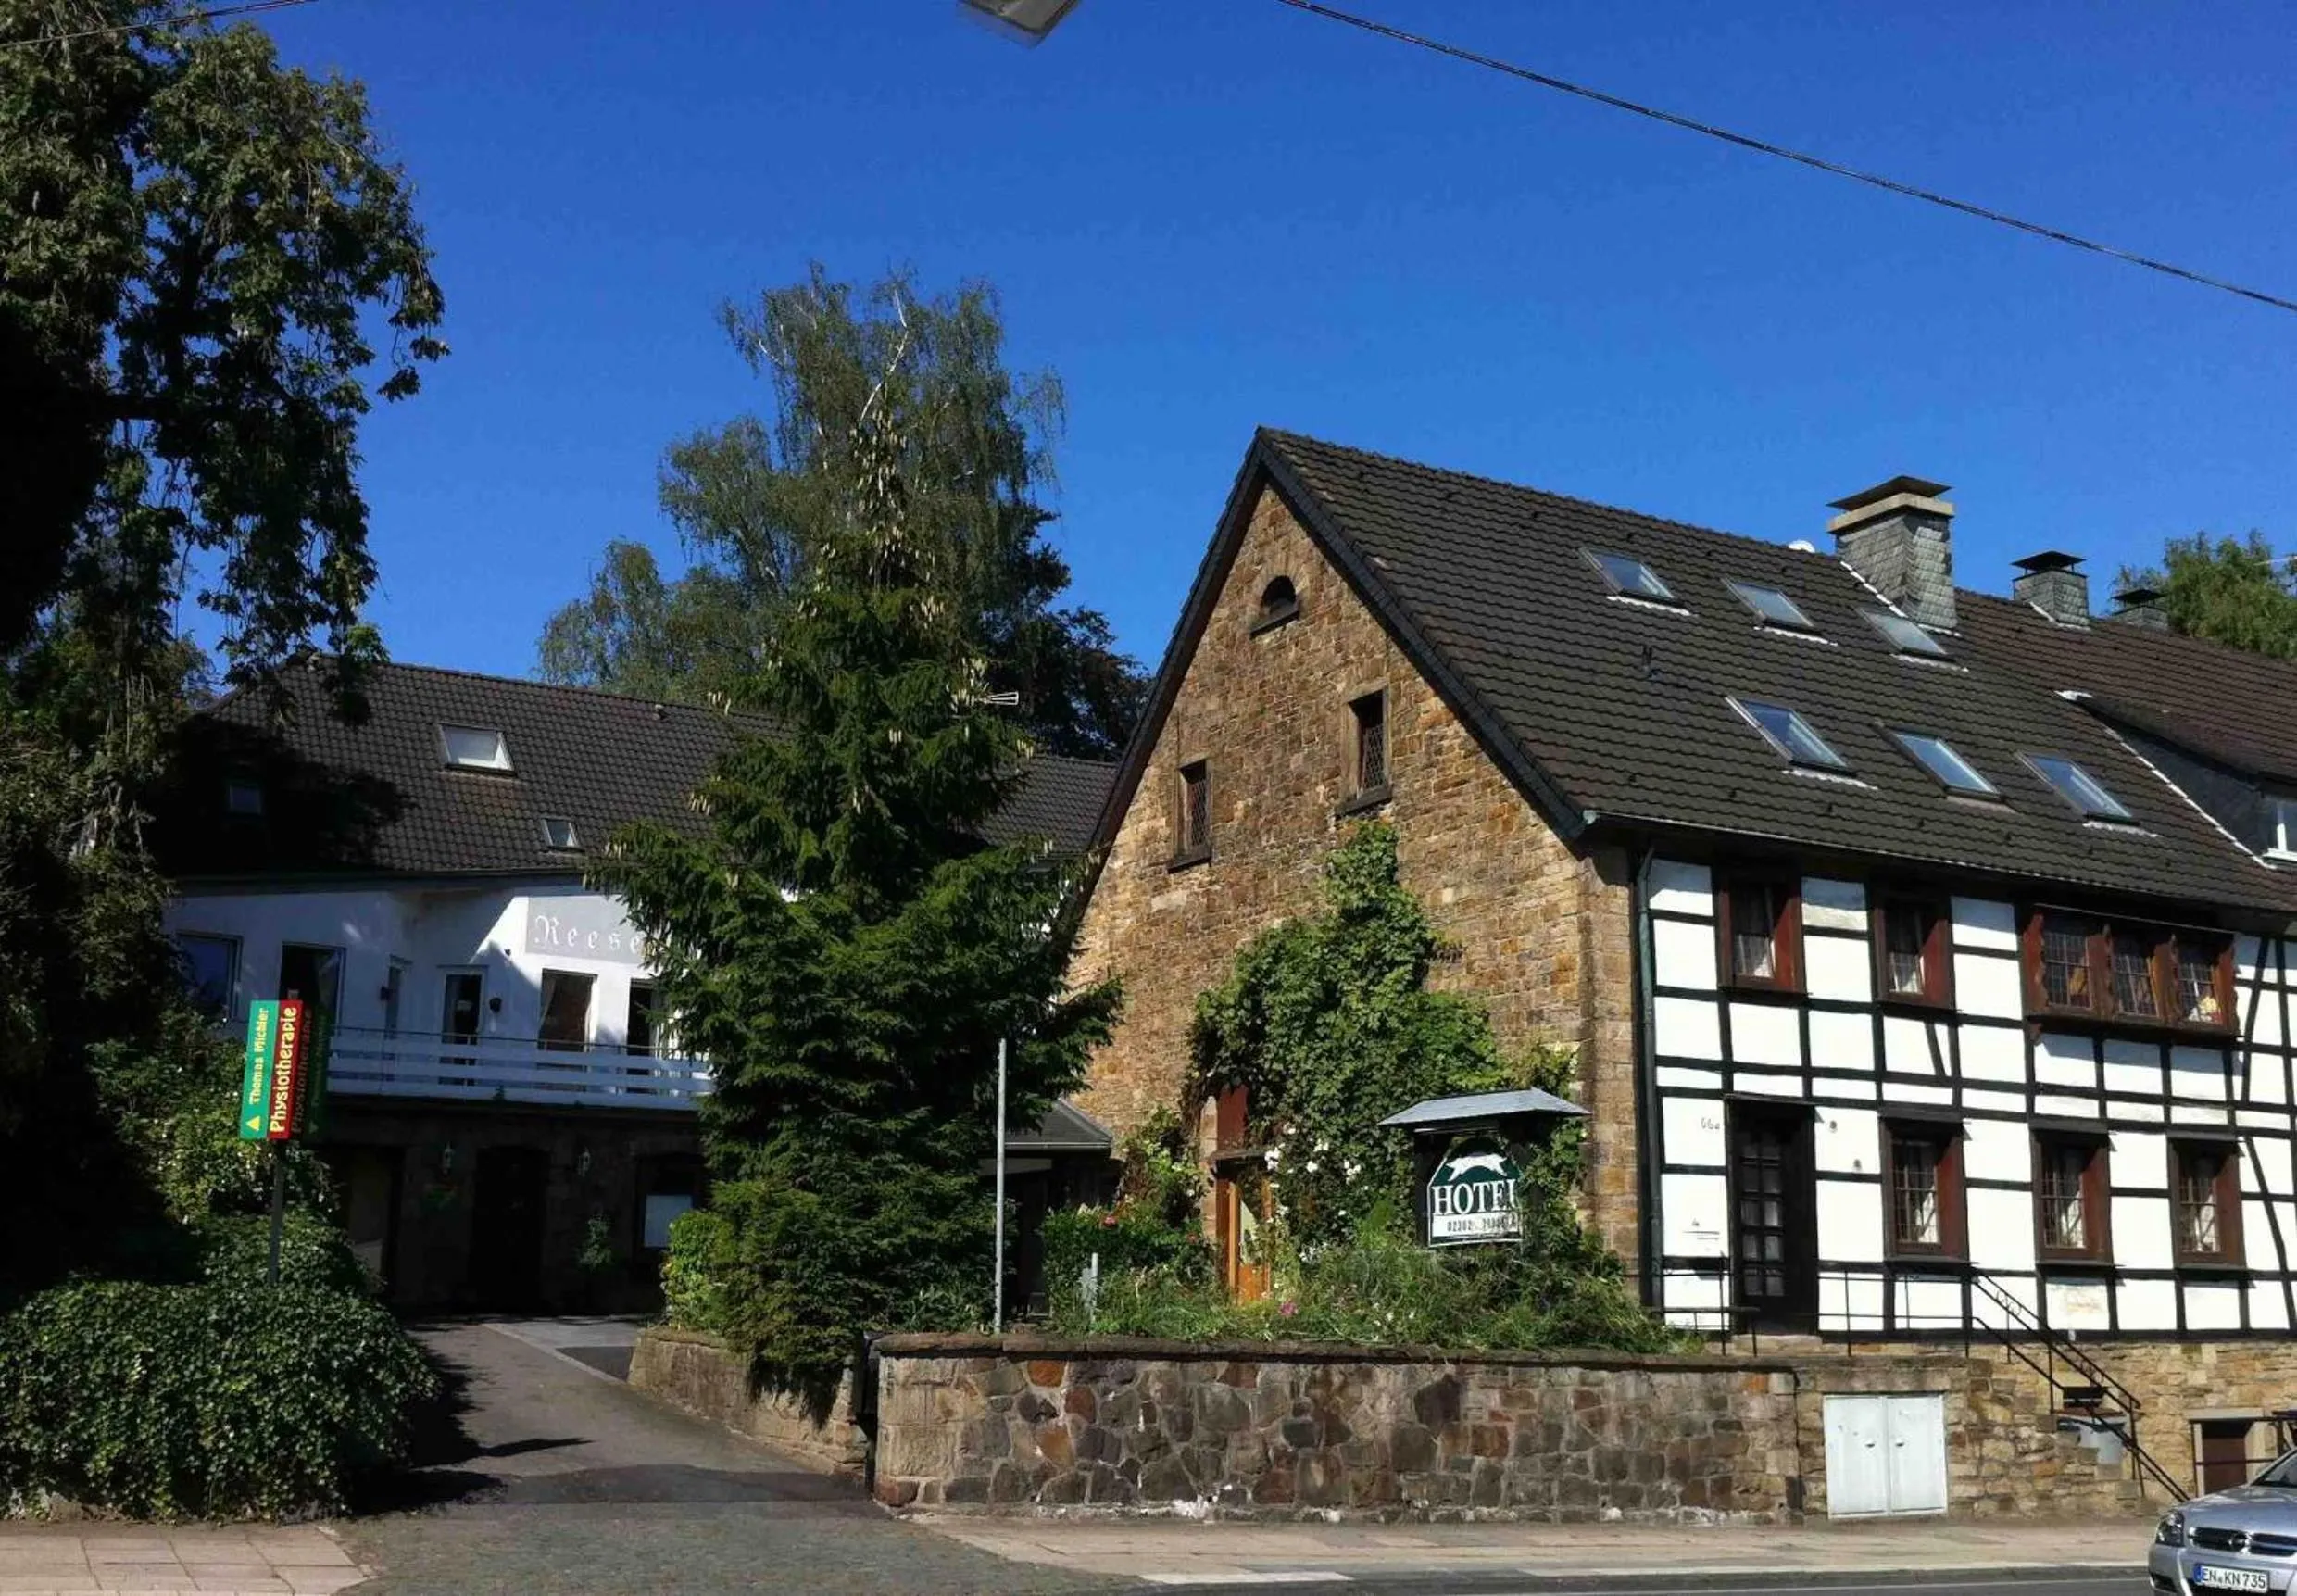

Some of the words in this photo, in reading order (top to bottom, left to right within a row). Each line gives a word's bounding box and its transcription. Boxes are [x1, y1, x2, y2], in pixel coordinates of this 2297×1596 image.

[248, 1057, 264, 1105] Thomas
[270, 1006, 297, 1134] Physiotherapie
[1431, 1178, 1517, 1216] HOTEL
